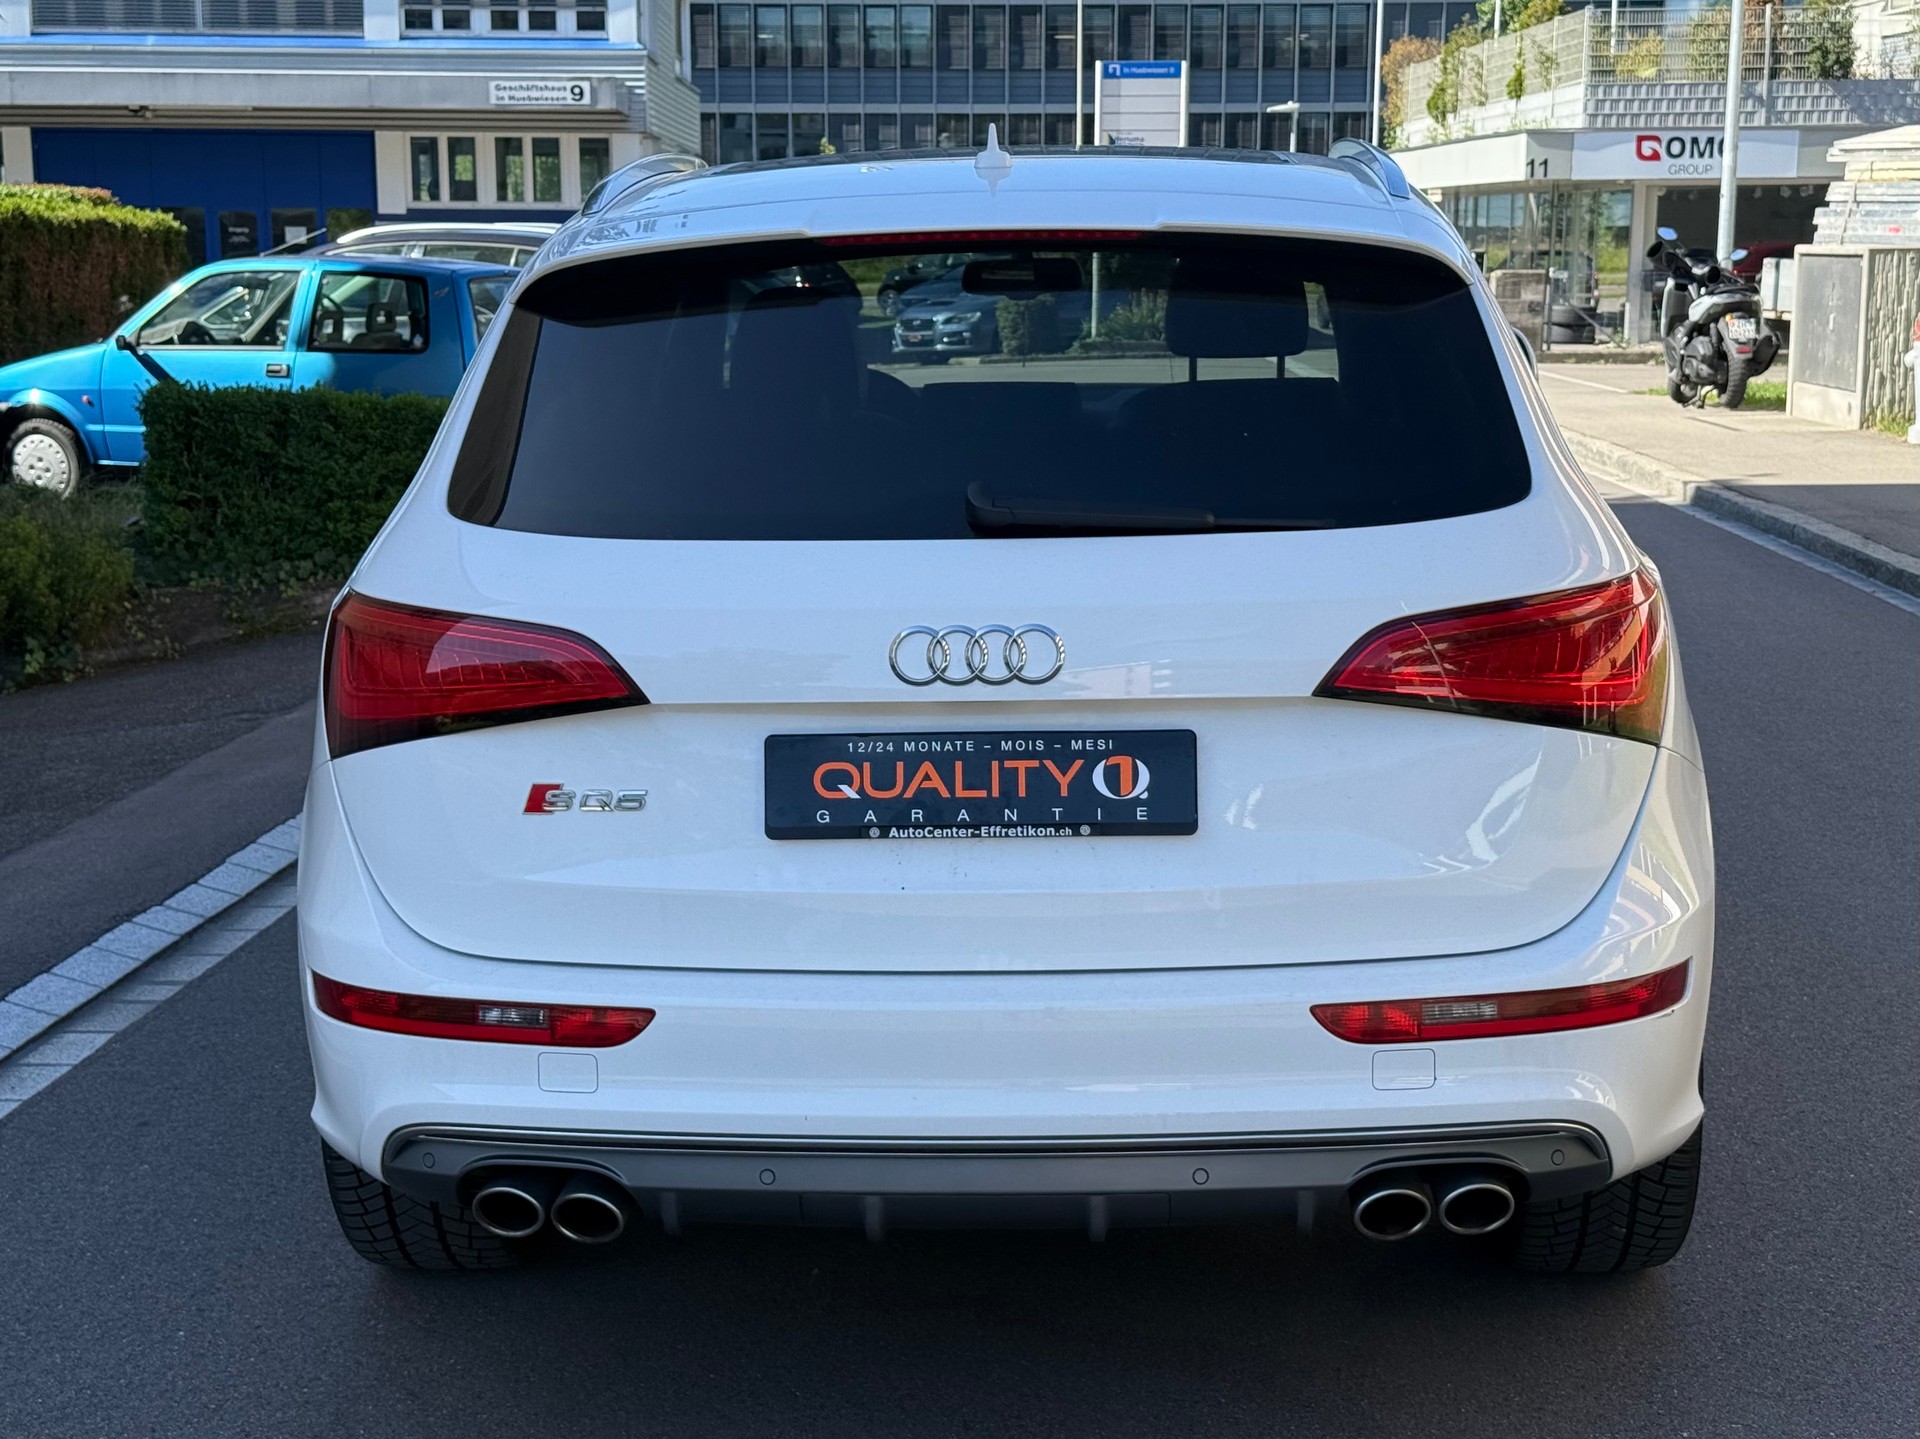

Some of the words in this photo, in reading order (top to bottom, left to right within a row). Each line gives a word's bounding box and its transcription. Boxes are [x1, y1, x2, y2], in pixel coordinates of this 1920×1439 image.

[570, 84, 584, 102] 9
[1526, 158, 1548, 178] 11
[1667, 164, 1713, 175] GROUP
[847, 741, 894, 753] 12/24
[904, 740, 974, 752] MONATE
[1001, 739, 1045, 751] MOIS
[1071, 739, 1113, 750] MESI
[813, 759, 1085, 799] QUALITY
[541, 788, 648, 812] SQ5
[816, 807, 1148, 823] GARANTIE
[888, 825, 1073, 838] AutoCenter-Effretikon.ch
